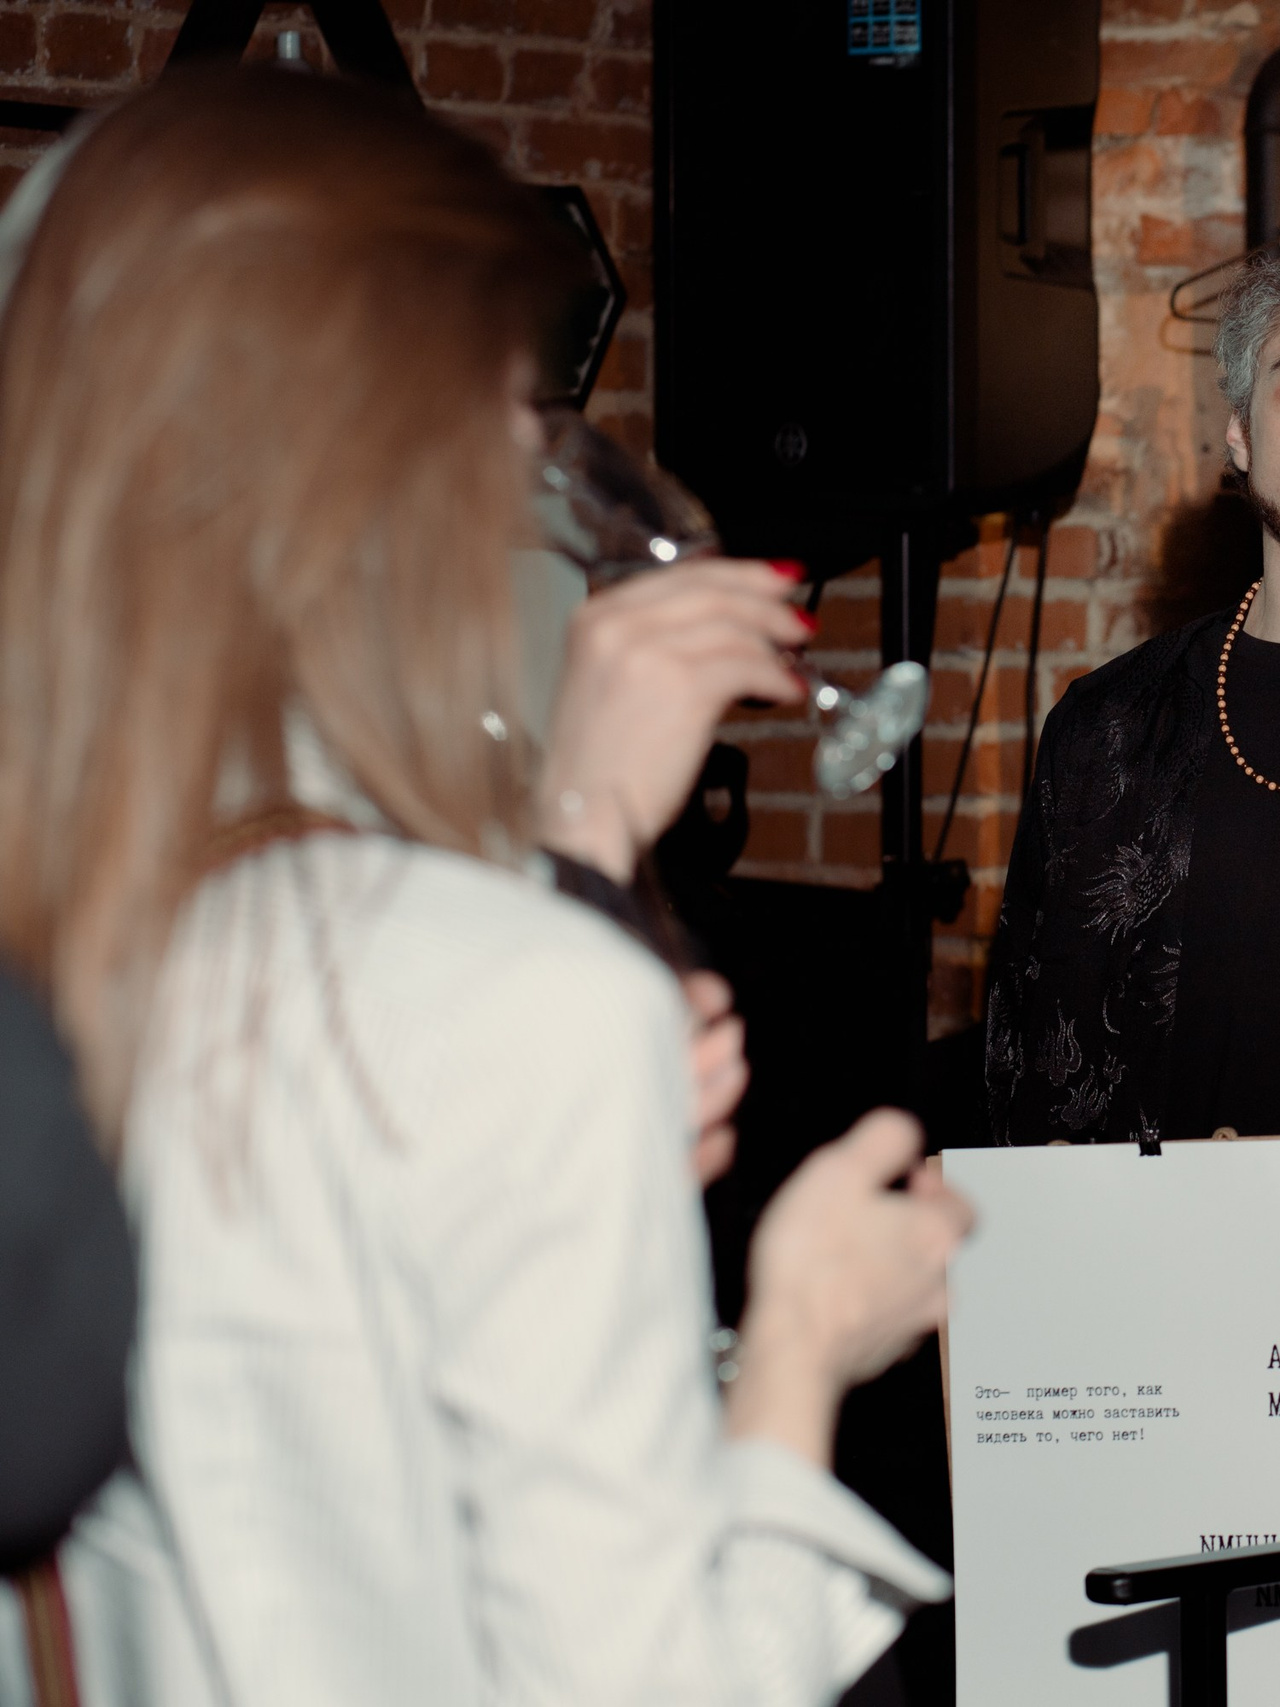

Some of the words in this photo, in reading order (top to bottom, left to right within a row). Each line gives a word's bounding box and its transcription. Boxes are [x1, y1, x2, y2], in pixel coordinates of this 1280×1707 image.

[1027, 1387, 1078, 1400] пример
[1086, 1385, 1127, 1398] того,
[1137, 1384, 1163, 1396] как
[976, 1408, 1044, 1421] человека
[1052, 1408, 1095, 1420] можно
[1104, 1406, 1180, 1419] заставить
[977, 1431, 1027, 1444] видеть
[1036, 1431, 1060, 1444] то,
[1070, 1430, 1104, 1442] чего
[1112, 1428, 1146, 1441] нет!
